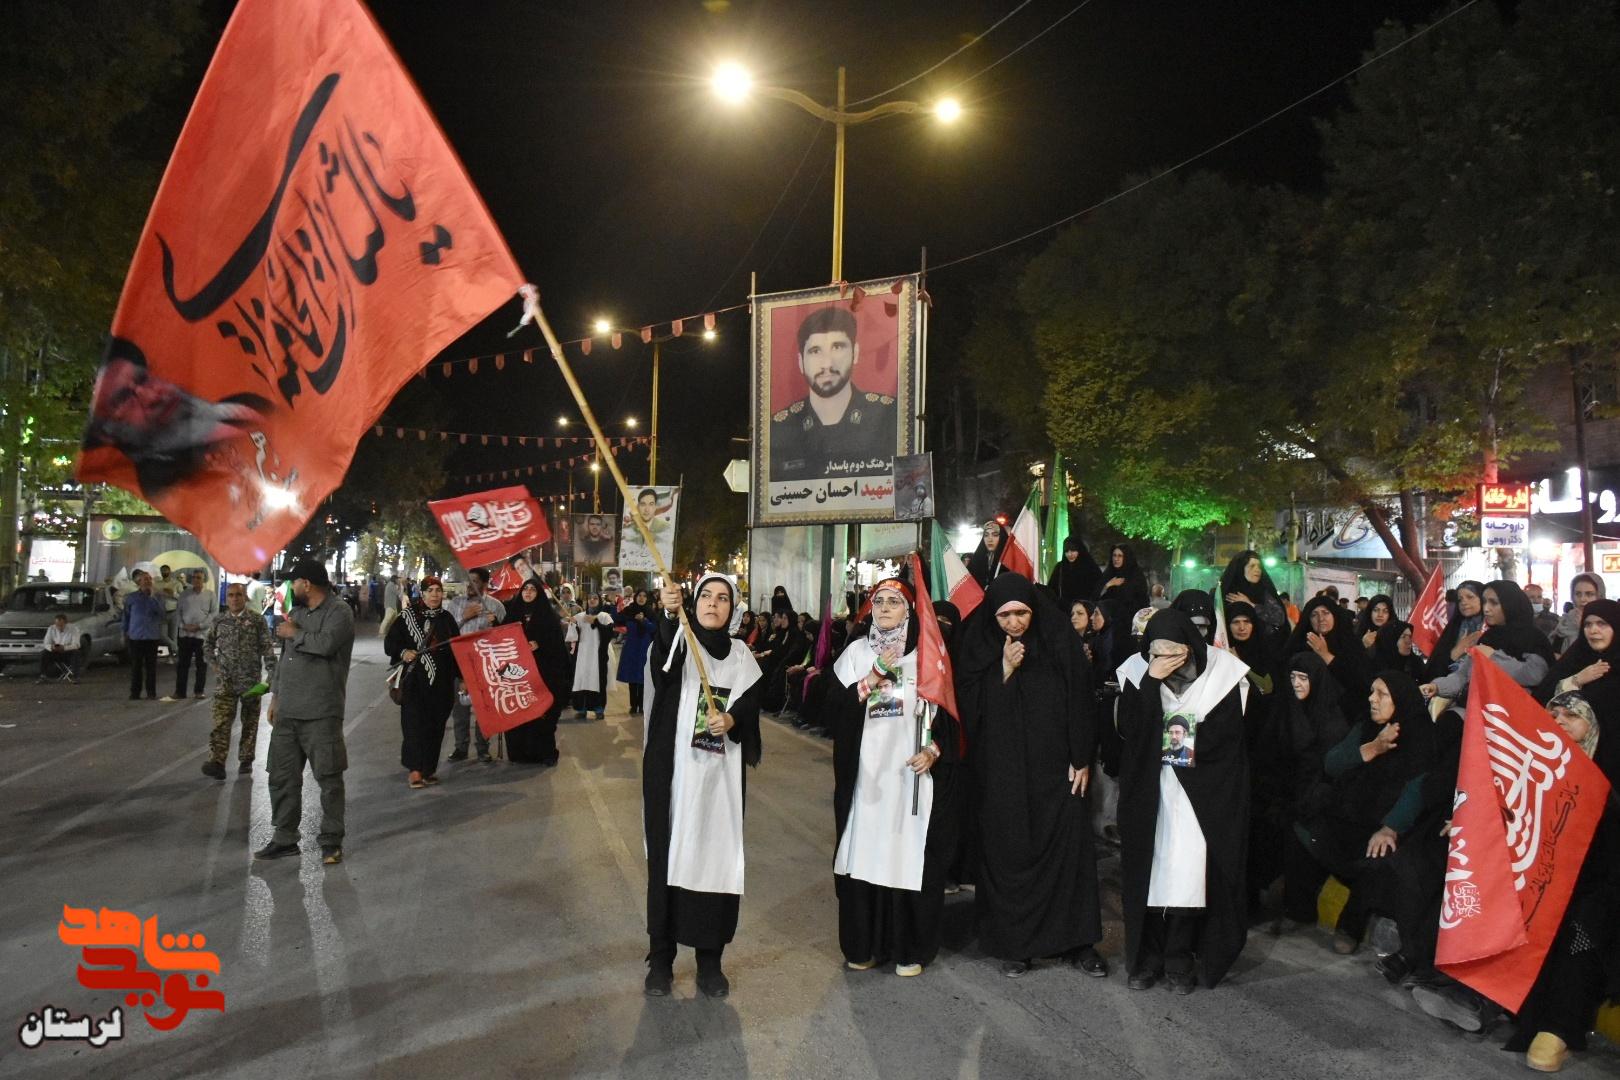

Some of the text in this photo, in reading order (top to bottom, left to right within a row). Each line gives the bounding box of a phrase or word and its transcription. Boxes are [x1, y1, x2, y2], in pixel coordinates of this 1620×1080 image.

[850, 460, 865, 473] دوم
[770, 485, 813, 506] حسینی
[816, 479, 858, 503] احسان
[861, 479, 894, 501] شهید
[1485, 521, 1525, 533] داروخانه
